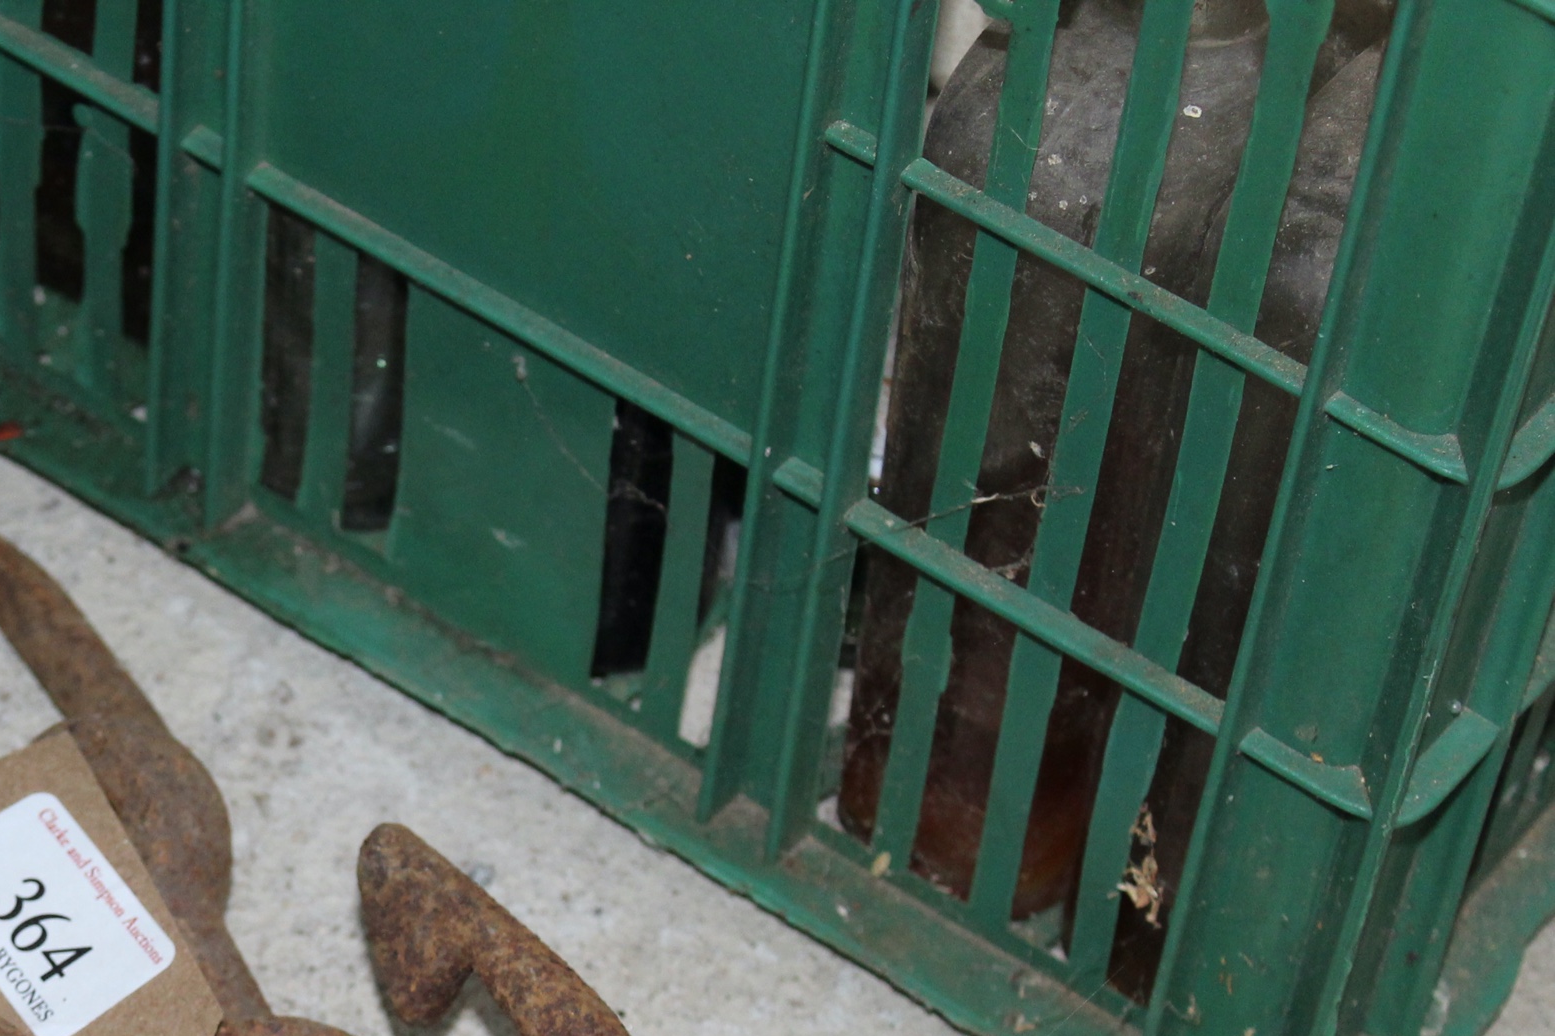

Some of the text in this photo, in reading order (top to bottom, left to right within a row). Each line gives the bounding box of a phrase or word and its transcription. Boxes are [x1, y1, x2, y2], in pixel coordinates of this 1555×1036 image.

[38, 807, 163, 965] Clarke and Simpson Auctions
